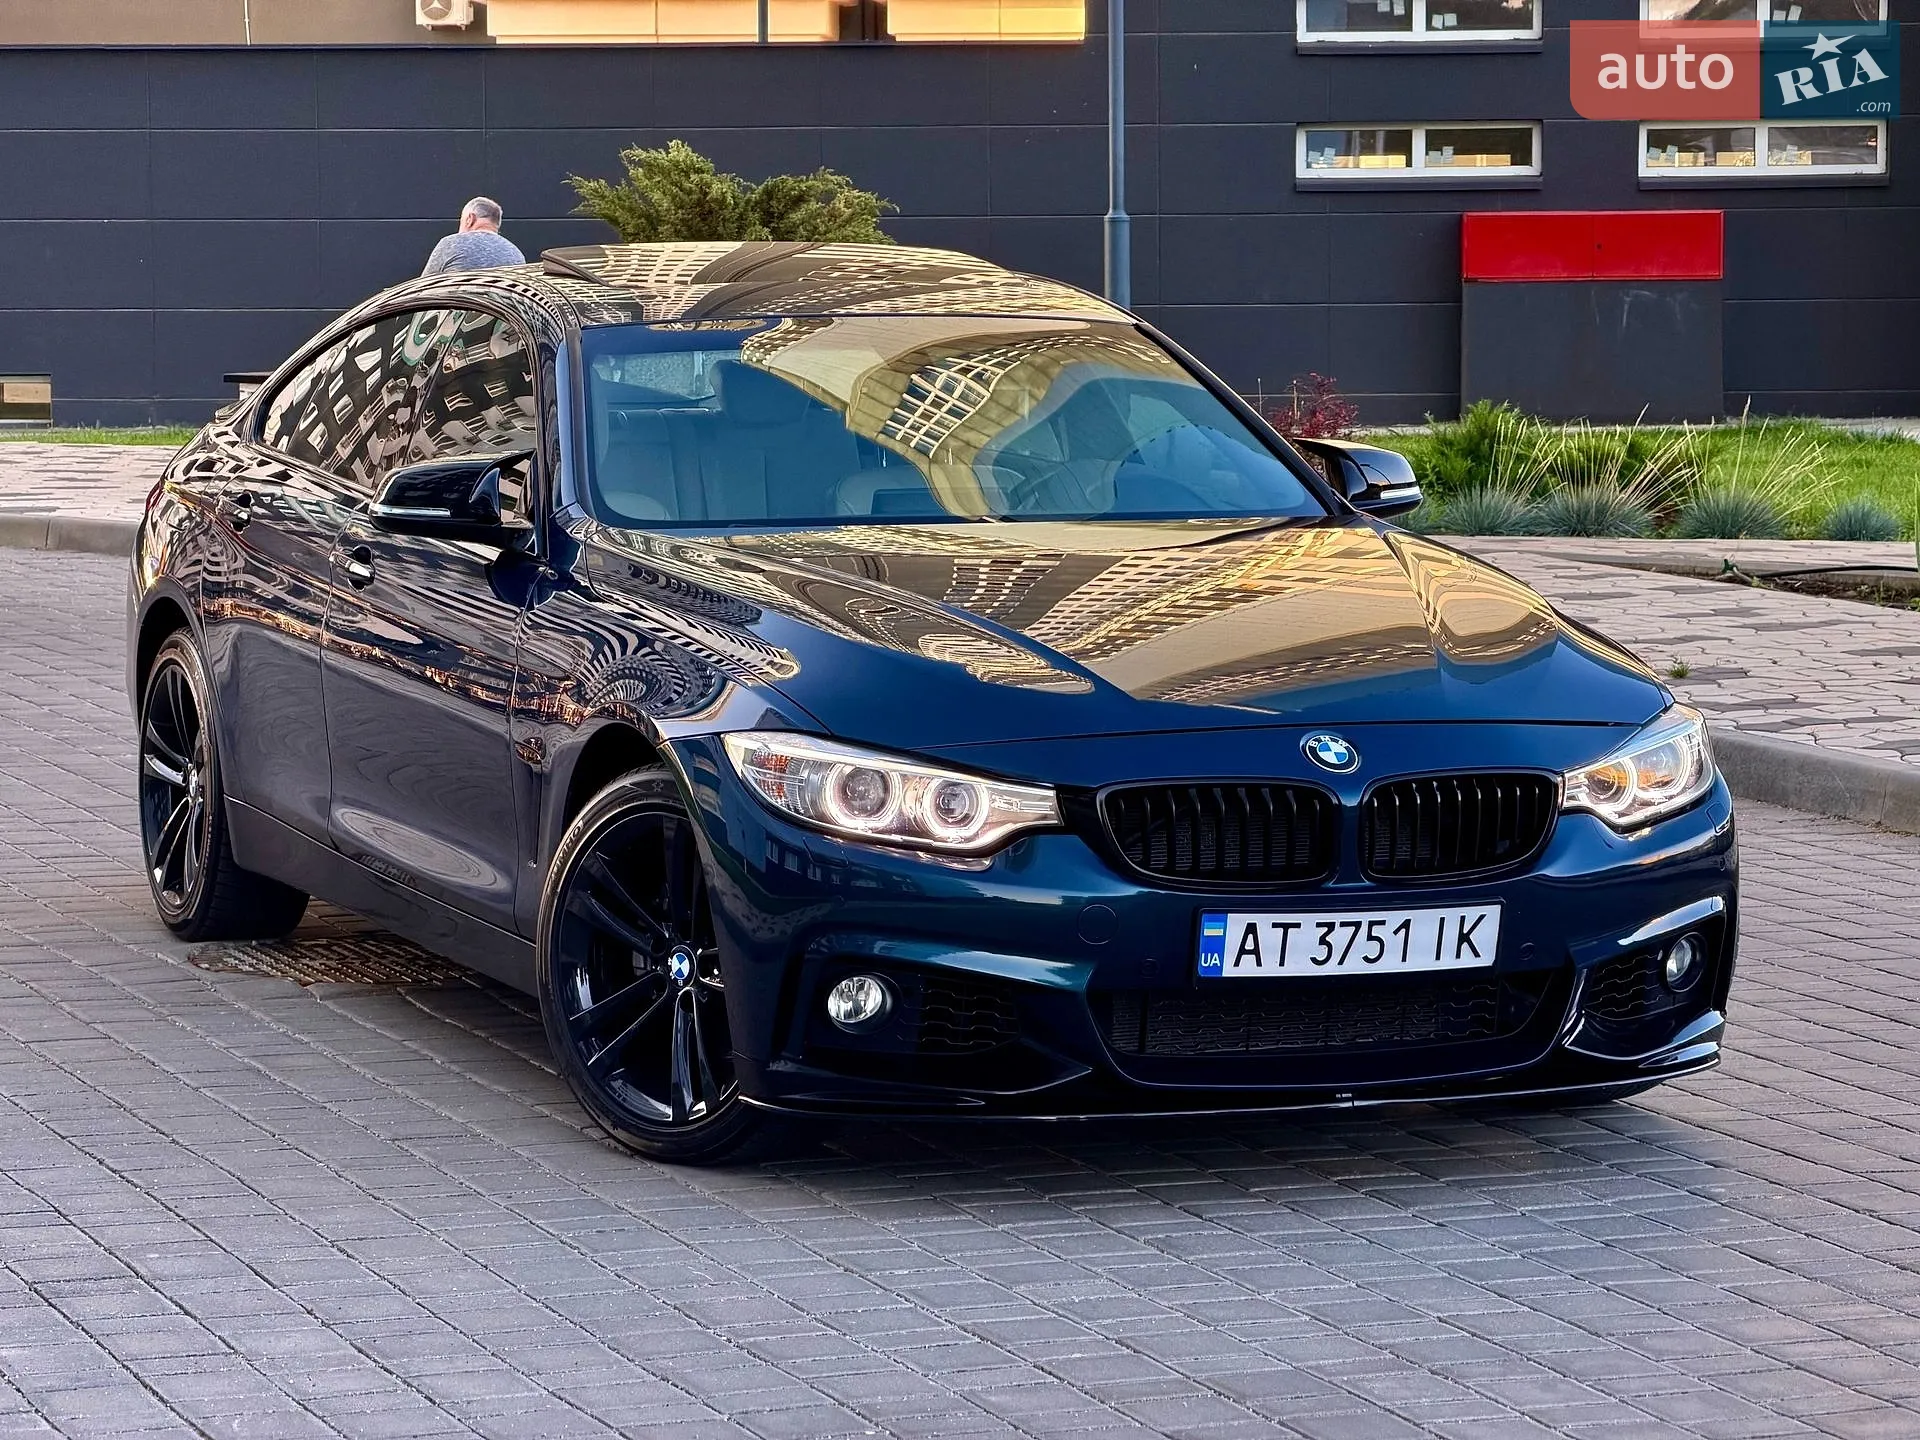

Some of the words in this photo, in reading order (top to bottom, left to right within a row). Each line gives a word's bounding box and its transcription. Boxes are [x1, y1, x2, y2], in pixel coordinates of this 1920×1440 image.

[1233, 922, 1302, 968] AT
[1309, 917, 1412, 966] 3751
[1435, 913, 1487, 961] IK
[1201, 953, 1220, 967] UA
